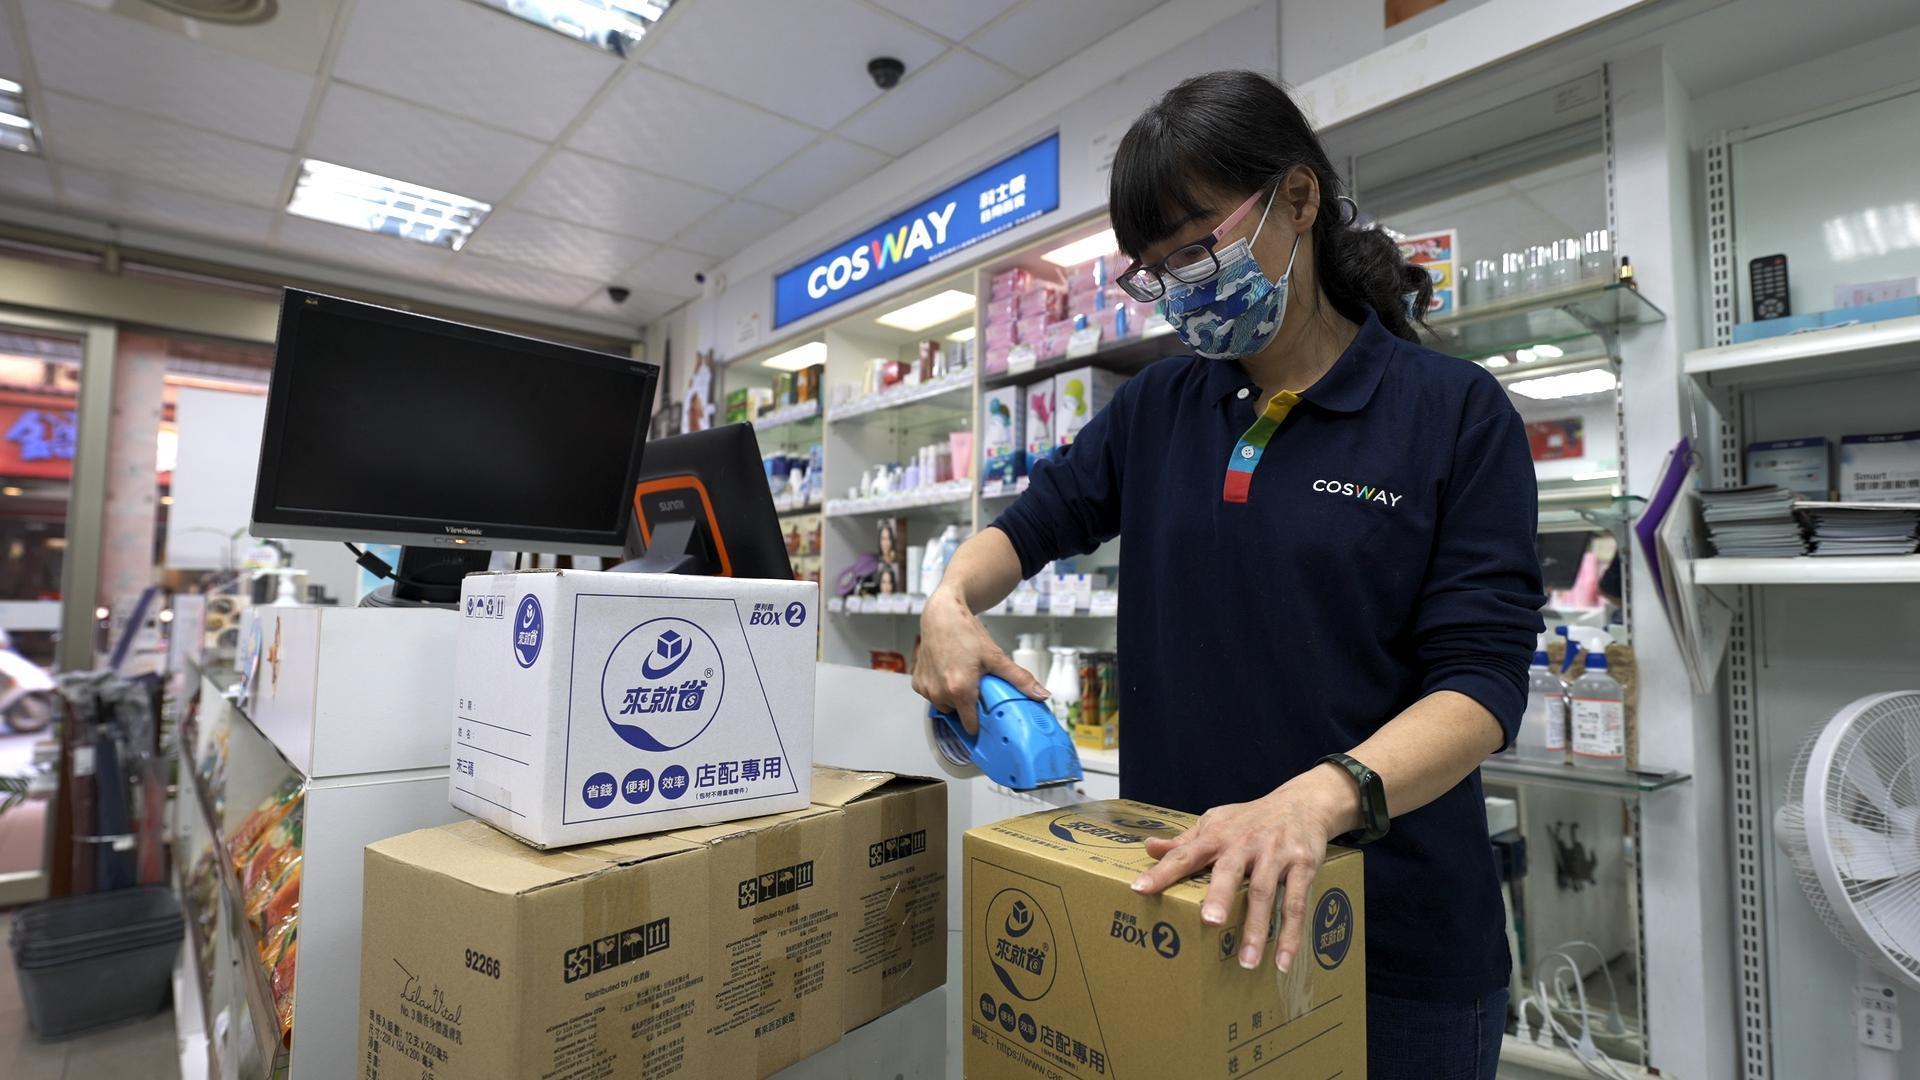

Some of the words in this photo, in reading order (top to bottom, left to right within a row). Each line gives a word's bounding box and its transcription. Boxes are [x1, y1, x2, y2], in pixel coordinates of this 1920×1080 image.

[807, 202, 957, 299] COSWAY
[1312, 480, 1403, 507] COSWAY
[445, 526, 482, 536] ViewSonic
[749, 611, 782, 626] BOX
[587, 783, 613, 799] 省錢
[625, 779, 650, 794] 便利
[662, 775, 685, 790] 效率
[694, 756, 781, 789] 店配專用
[1113, 910, 1137, 926] 便利箱
[1110, 920, 1148, 948] BOX
[465, 948, 500, 980] 92266
[994, 938, 1046, 976] 來就省
[585, 979, 620, 1000] Distributed
[620, 978, 629, 988] by
[1040, 1025, 1105, 1074] 店配專用
